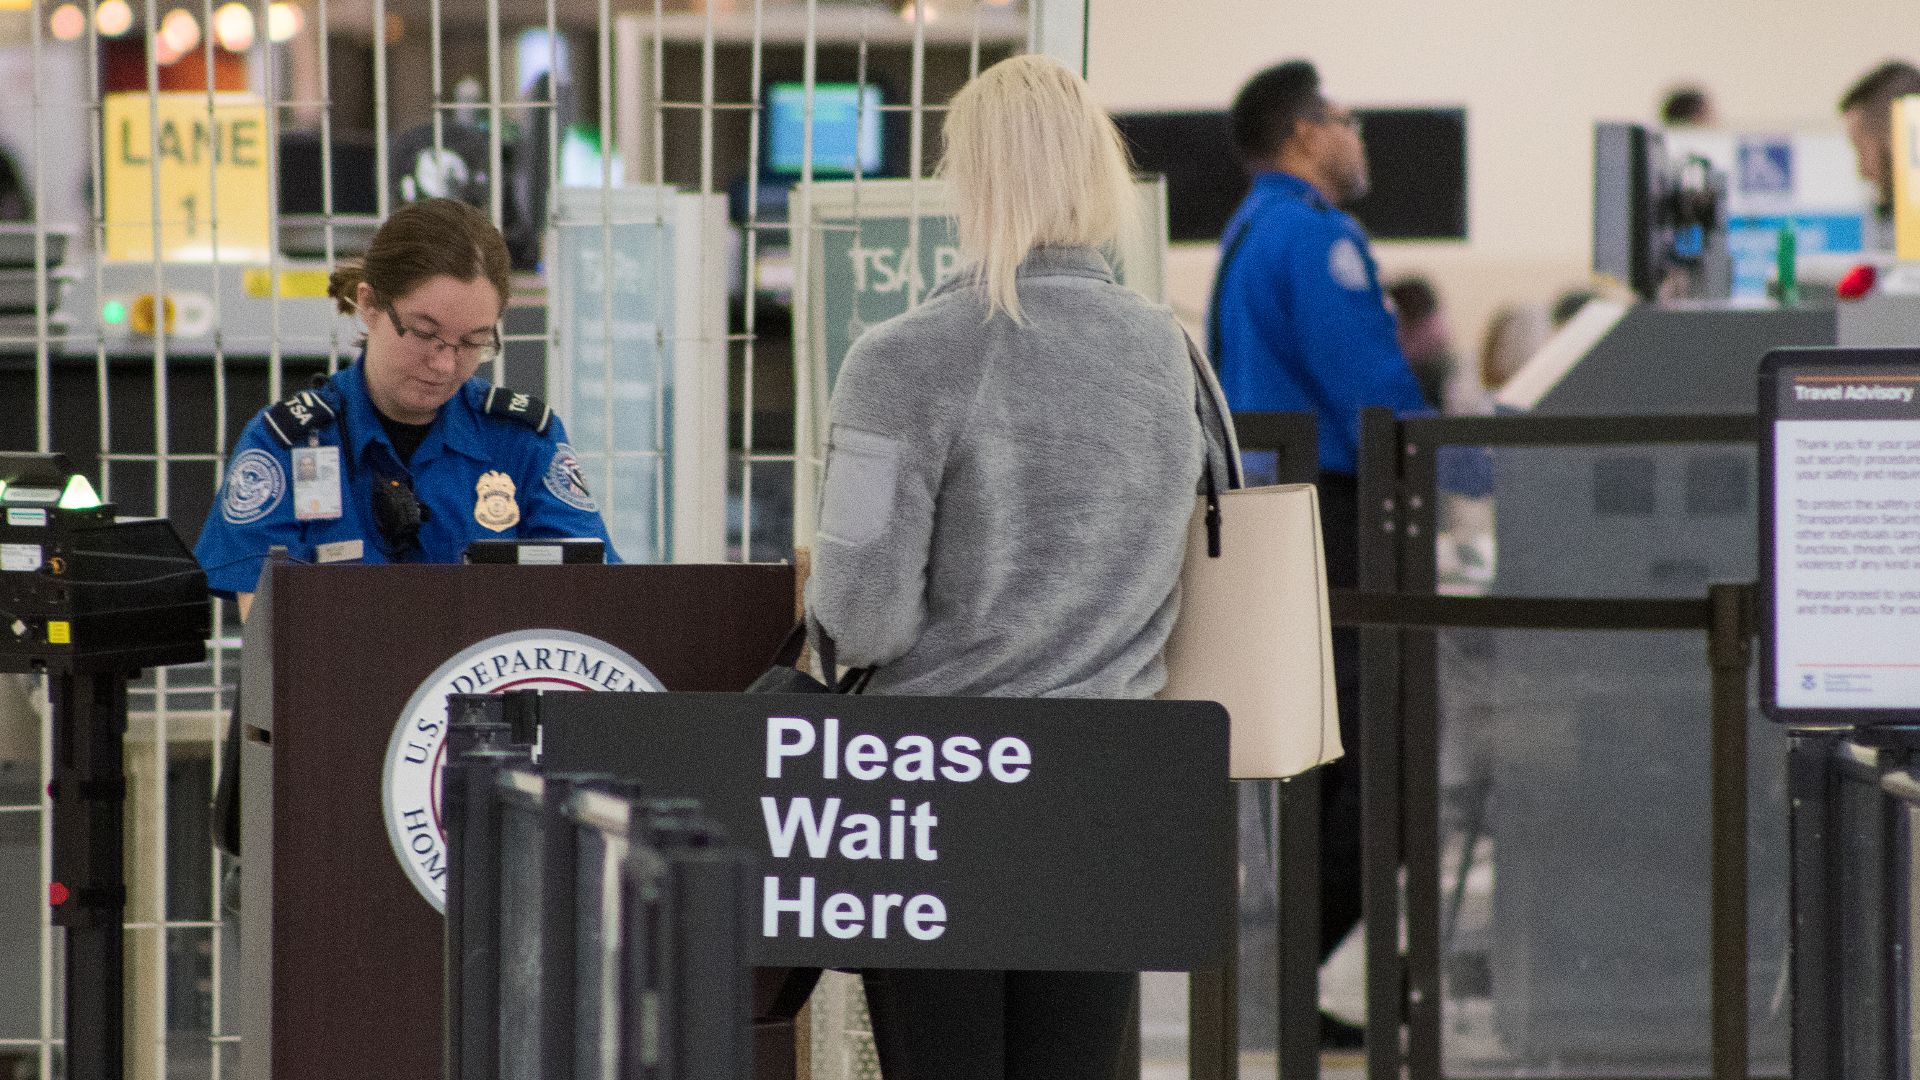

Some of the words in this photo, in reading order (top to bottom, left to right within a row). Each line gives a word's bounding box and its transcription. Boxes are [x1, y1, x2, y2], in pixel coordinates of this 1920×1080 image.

[121, 119, 260, 167] LANE
[180, 194, 197, 237] 1
[848, 247, 926, 292] TSA
[285, 397, 313, 426] TSA
[1794, 384, 1843, 400] Travel
[1845, 384, 1915, 402] Advisory
[766, 717, 1032, 783] Please
[403, 808, 447, 891] HOM
[760, 796, 938, 861] Wait
[763, 876, 947, 941] Here
